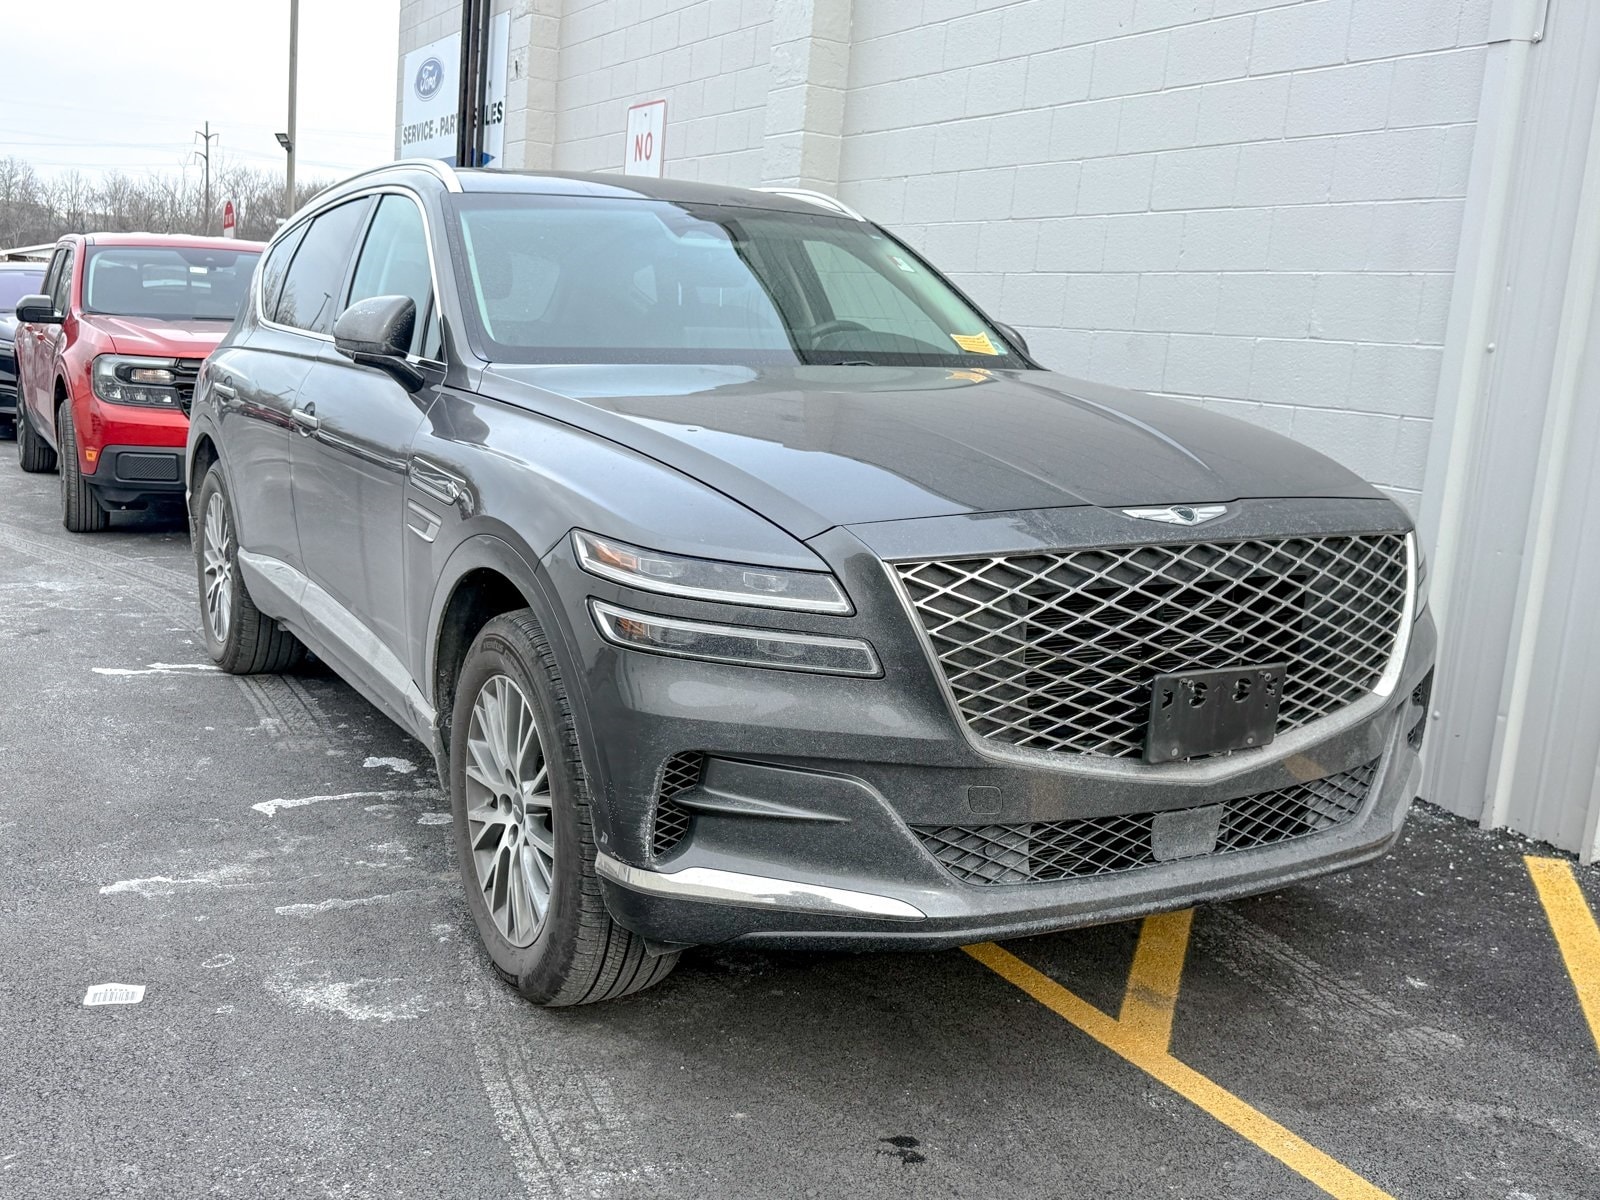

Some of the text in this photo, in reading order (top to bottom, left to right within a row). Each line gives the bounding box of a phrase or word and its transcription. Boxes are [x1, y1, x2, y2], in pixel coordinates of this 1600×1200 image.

[419, 63, 438, 92] Ford
[403, 120, 434, 145] SERVICE
[634, 132, 653, 162] NO
